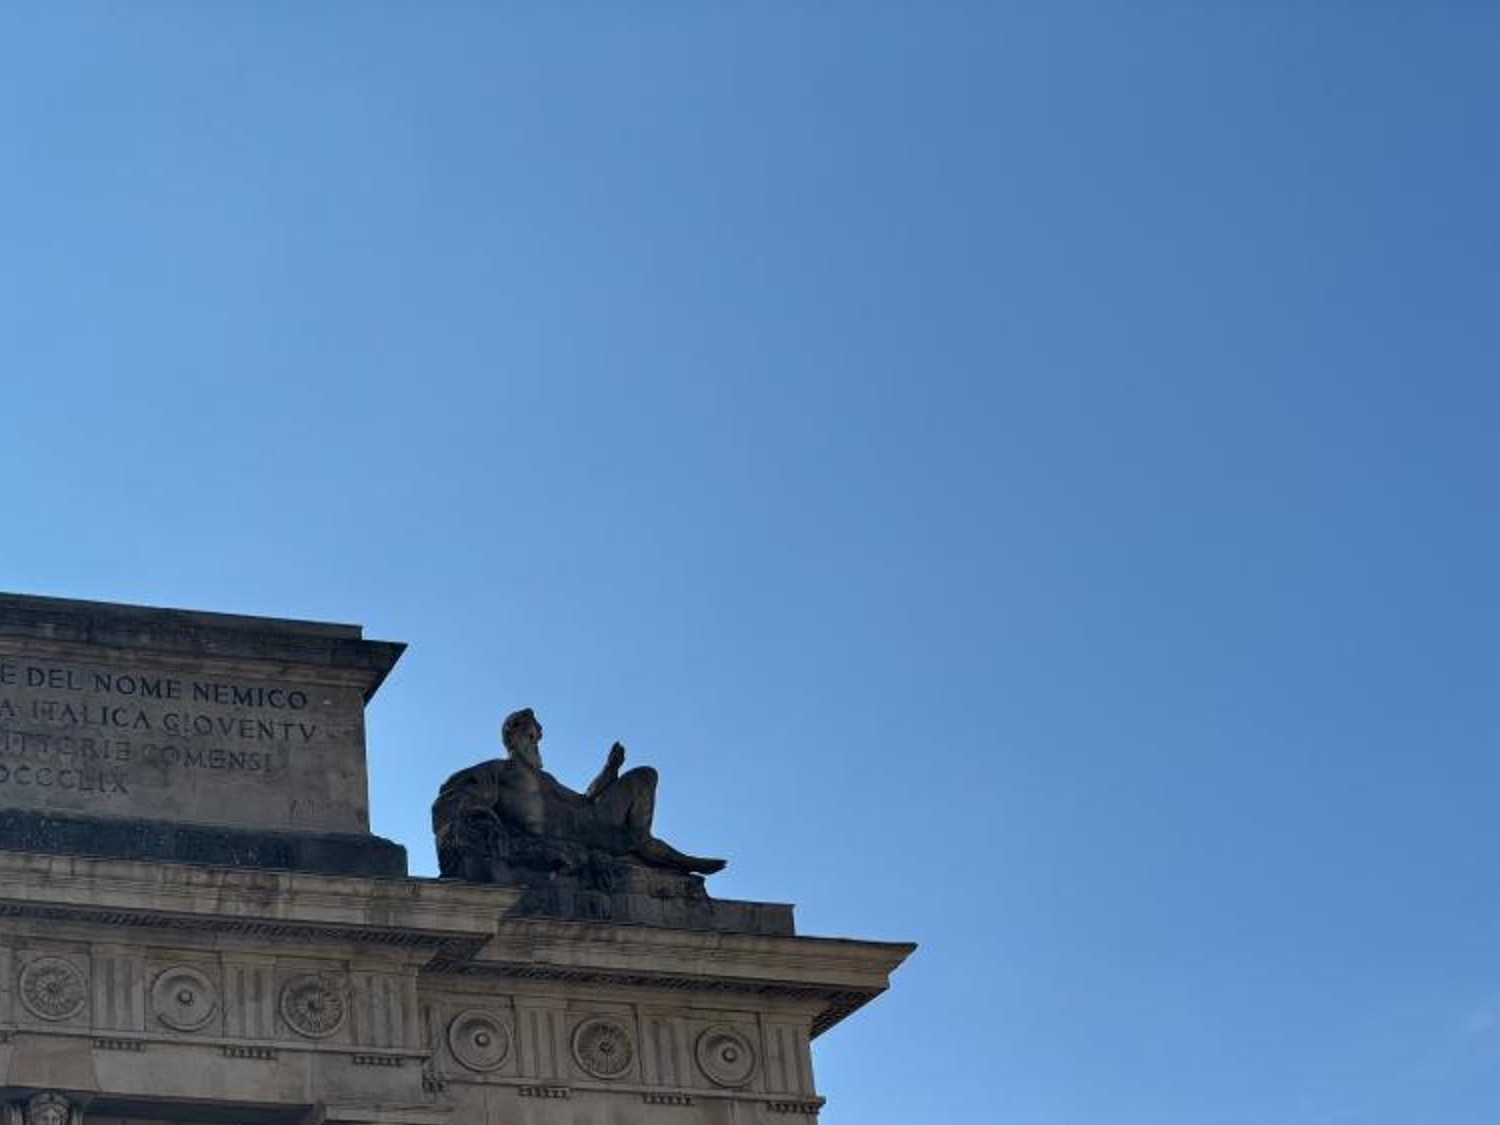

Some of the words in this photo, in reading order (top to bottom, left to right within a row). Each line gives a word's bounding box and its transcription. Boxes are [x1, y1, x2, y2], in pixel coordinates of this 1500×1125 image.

[27, 667, 82, 690] DEL
[95, 674, 181, 699] NOME
[193, 682, 308, 710] NEMICO
[32, 700, 150, 731] ITALICA
